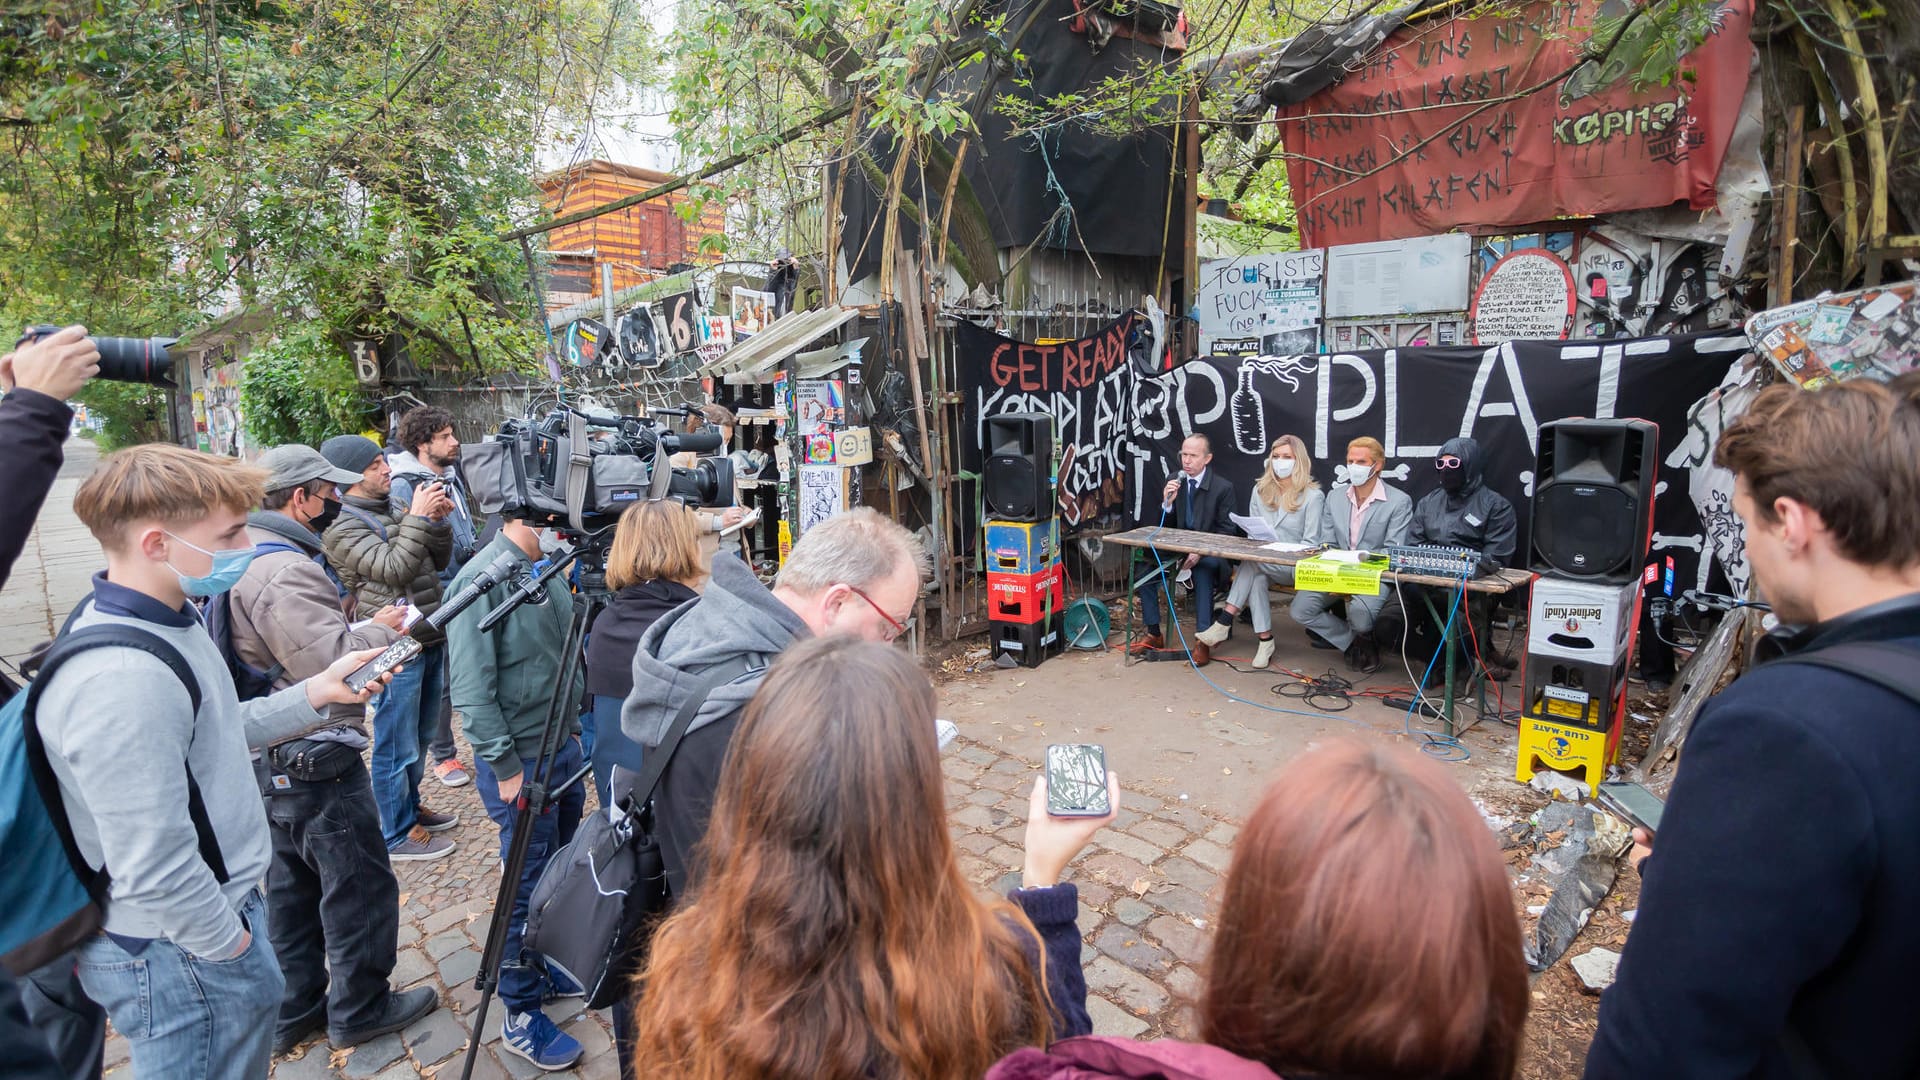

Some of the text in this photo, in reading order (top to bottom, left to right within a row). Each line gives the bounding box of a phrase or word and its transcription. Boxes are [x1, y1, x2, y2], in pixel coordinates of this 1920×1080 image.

[1418, 31, 1472, 68] UNS
[1420, 65, 1511, 108] LASST
[1304, 146, 1378, 189] ASSEN
[1447, 112, 1518, 158] EUCH
[1376, 148, 1514, 214] CHLAFEN!
[1214, 254, 1322, 290] TOURISTS
[1214, 288, 1266, 320] FUCK
[990, 313, 1134, 392] GET READY
[1314, 337, 1752, 459] PLAT
[1544, 606, 1602, 620] Berliner Kindl
[1532, 723, 1590, 741] CLUB-MATE
